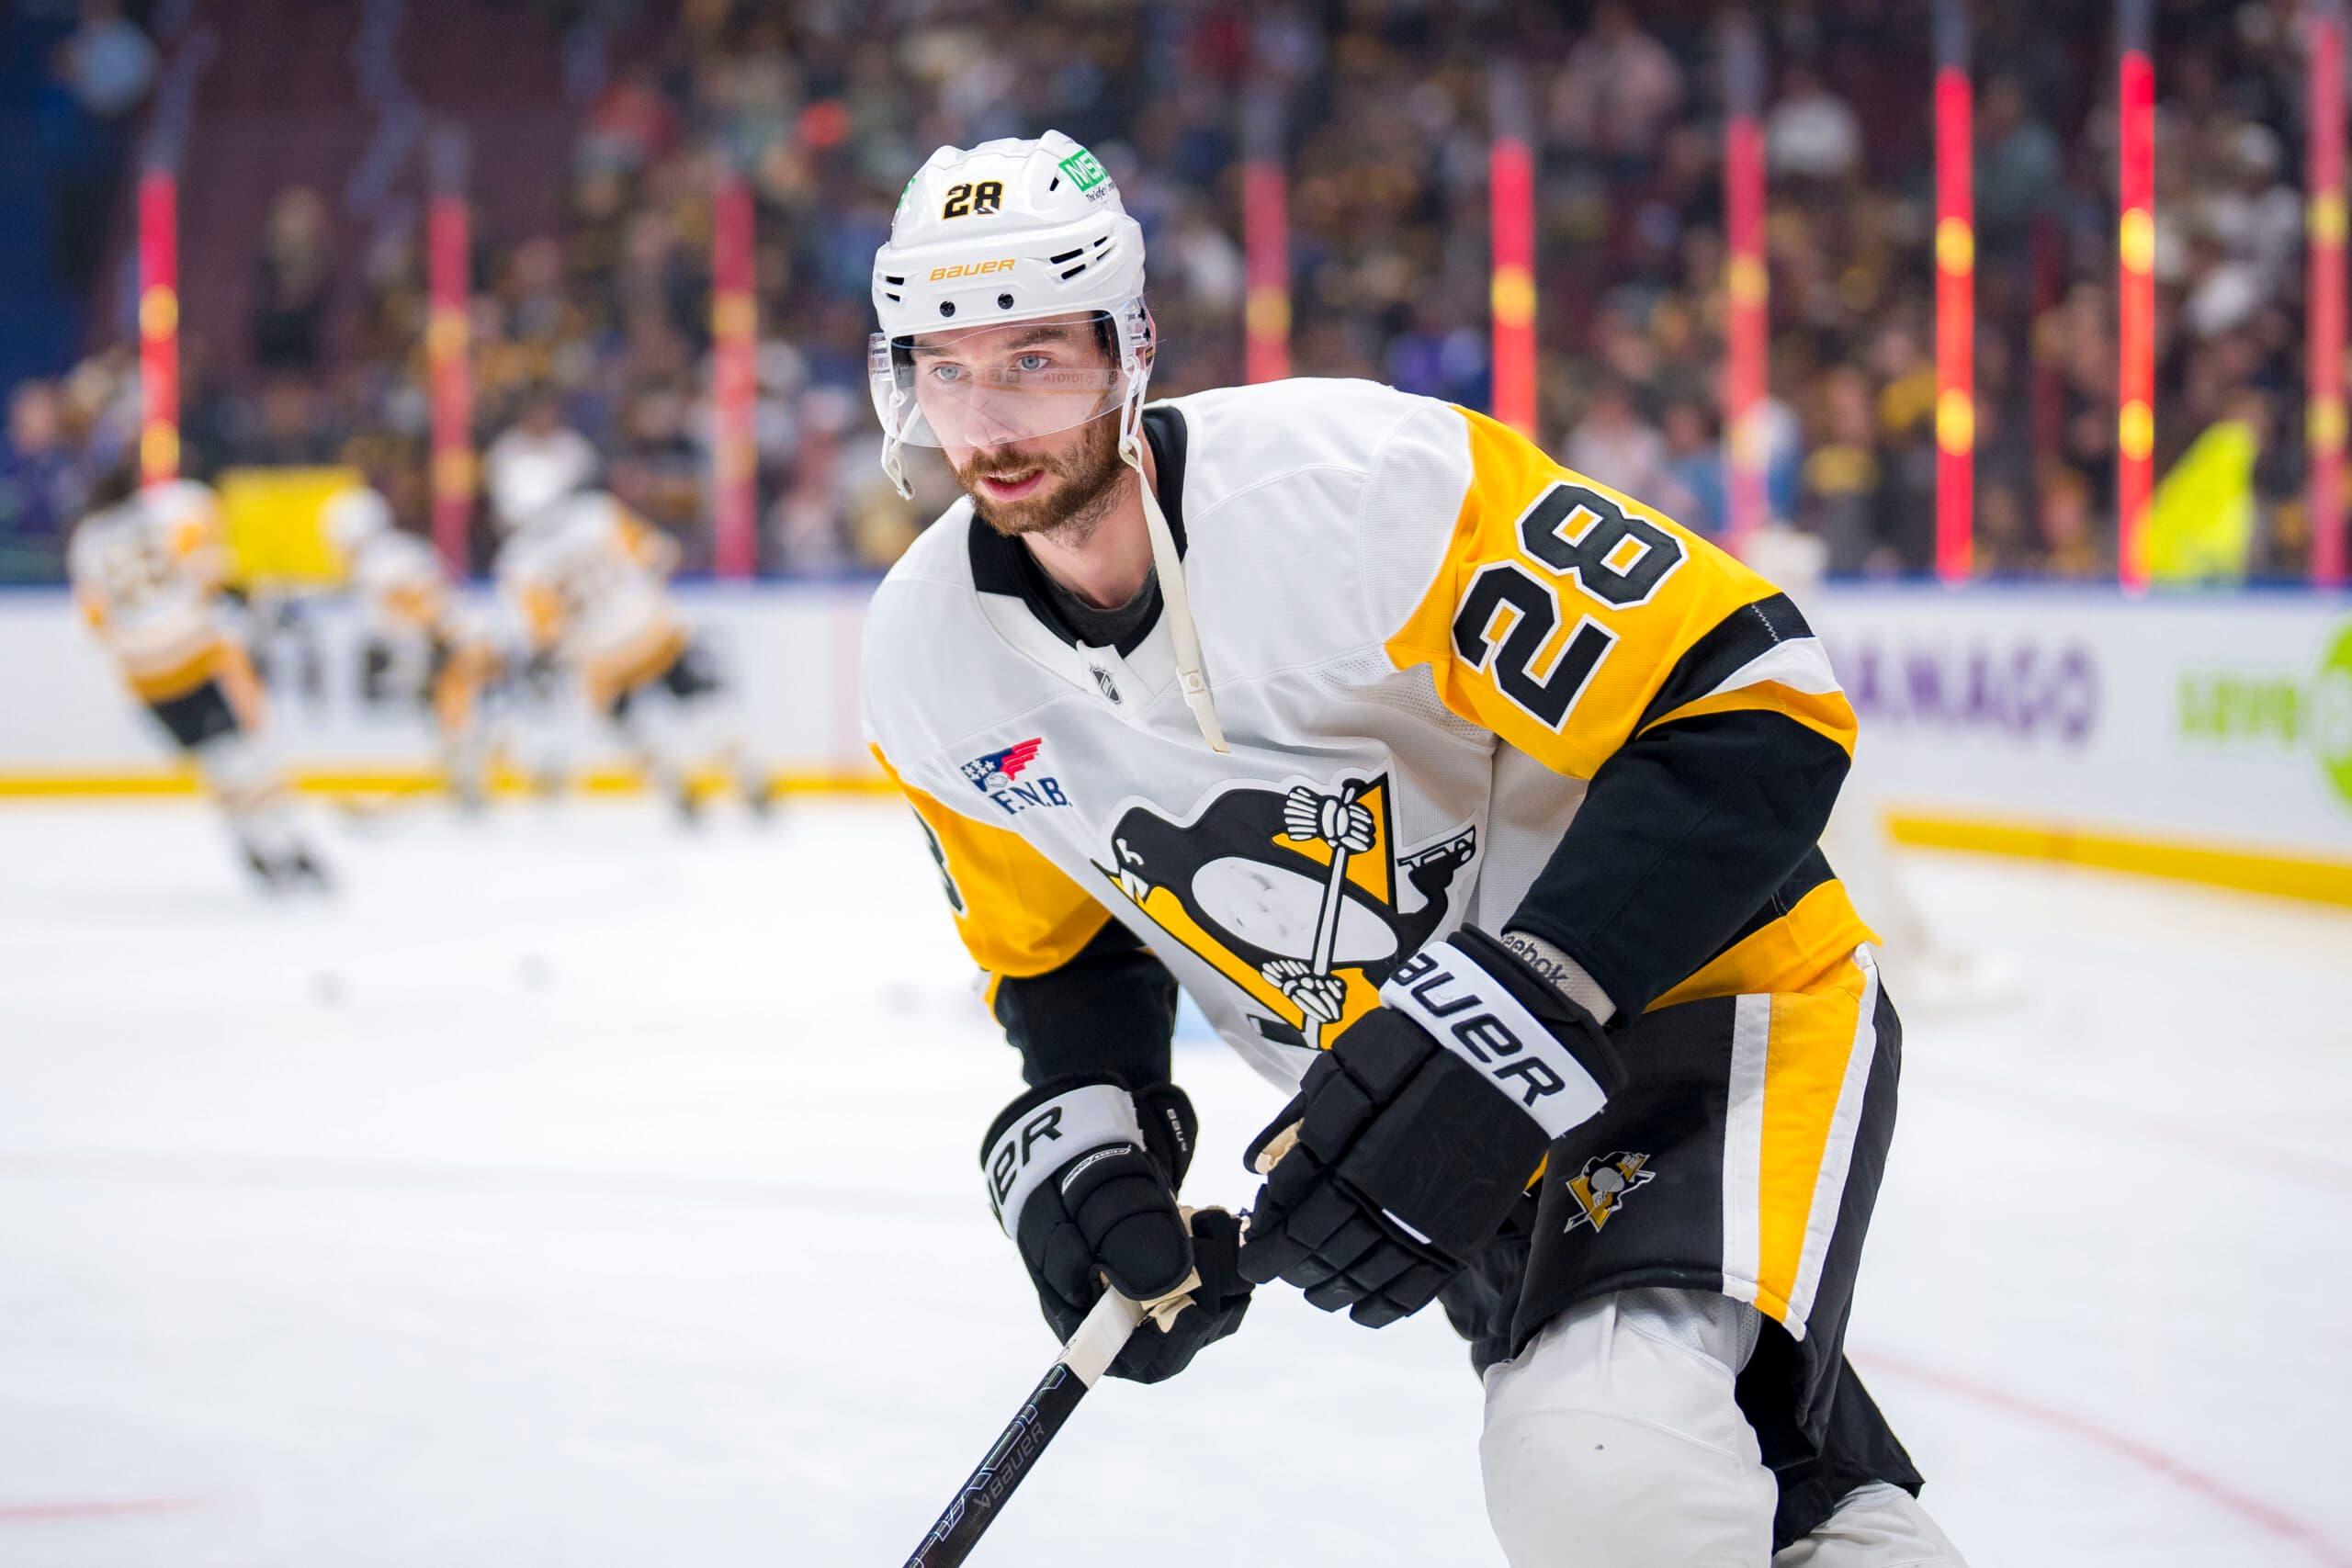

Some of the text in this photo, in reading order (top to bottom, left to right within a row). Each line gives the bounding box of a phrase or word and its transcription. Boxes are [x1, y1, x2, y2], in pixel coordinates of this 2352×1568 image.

[941, 181, 1003, 220] 28
[929, 258, 1015, 281] BAUER
[1451, 479, 1690, 735] 28
[1500, 933, 1568, 985] eebok
[1390, 952, 1566, 1107] AUER
